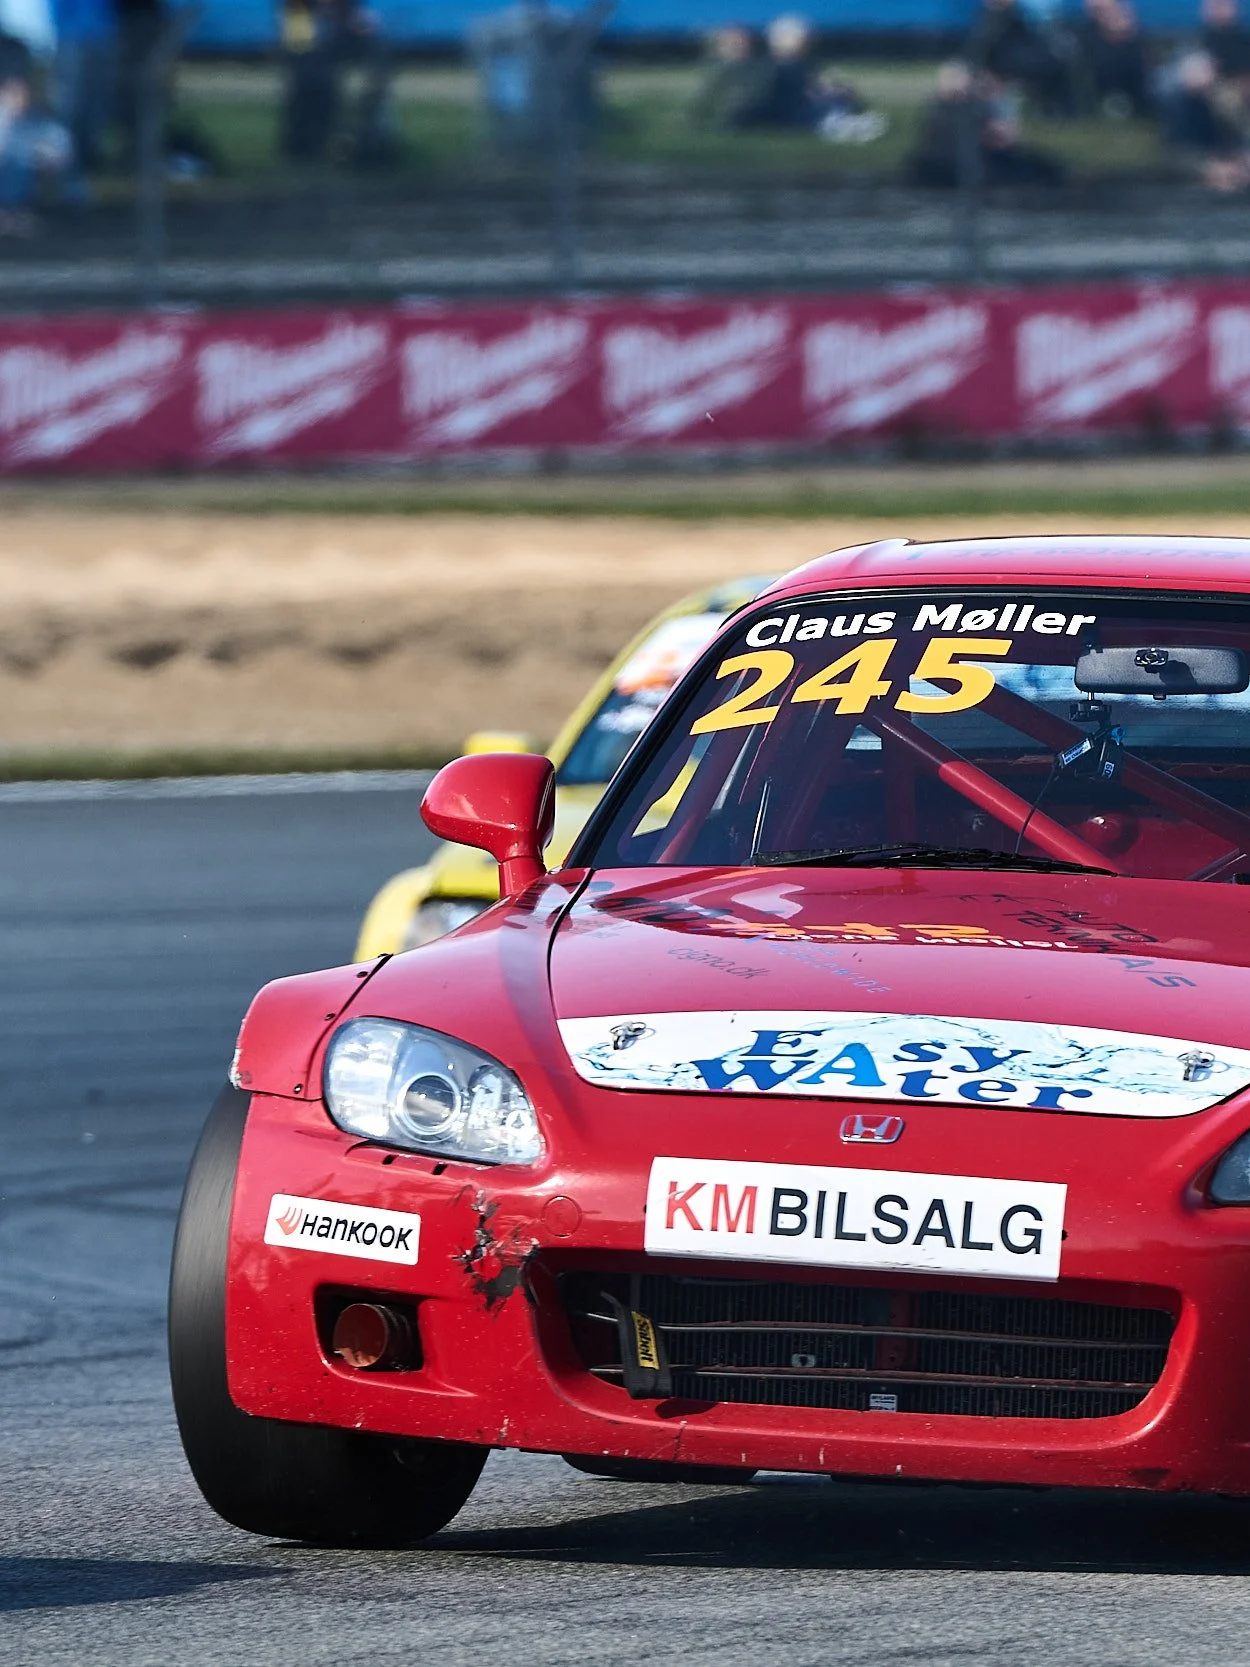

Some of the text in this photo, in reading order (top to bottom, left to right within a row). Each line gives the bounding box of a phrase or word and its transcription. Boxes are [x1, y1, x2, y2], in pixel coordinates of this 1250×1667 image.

[745, 603, 1096, 647] Claus Møller
[689, 636, 1013, 736] 245
[768, 1186, 1044, 1256] BILSALG
